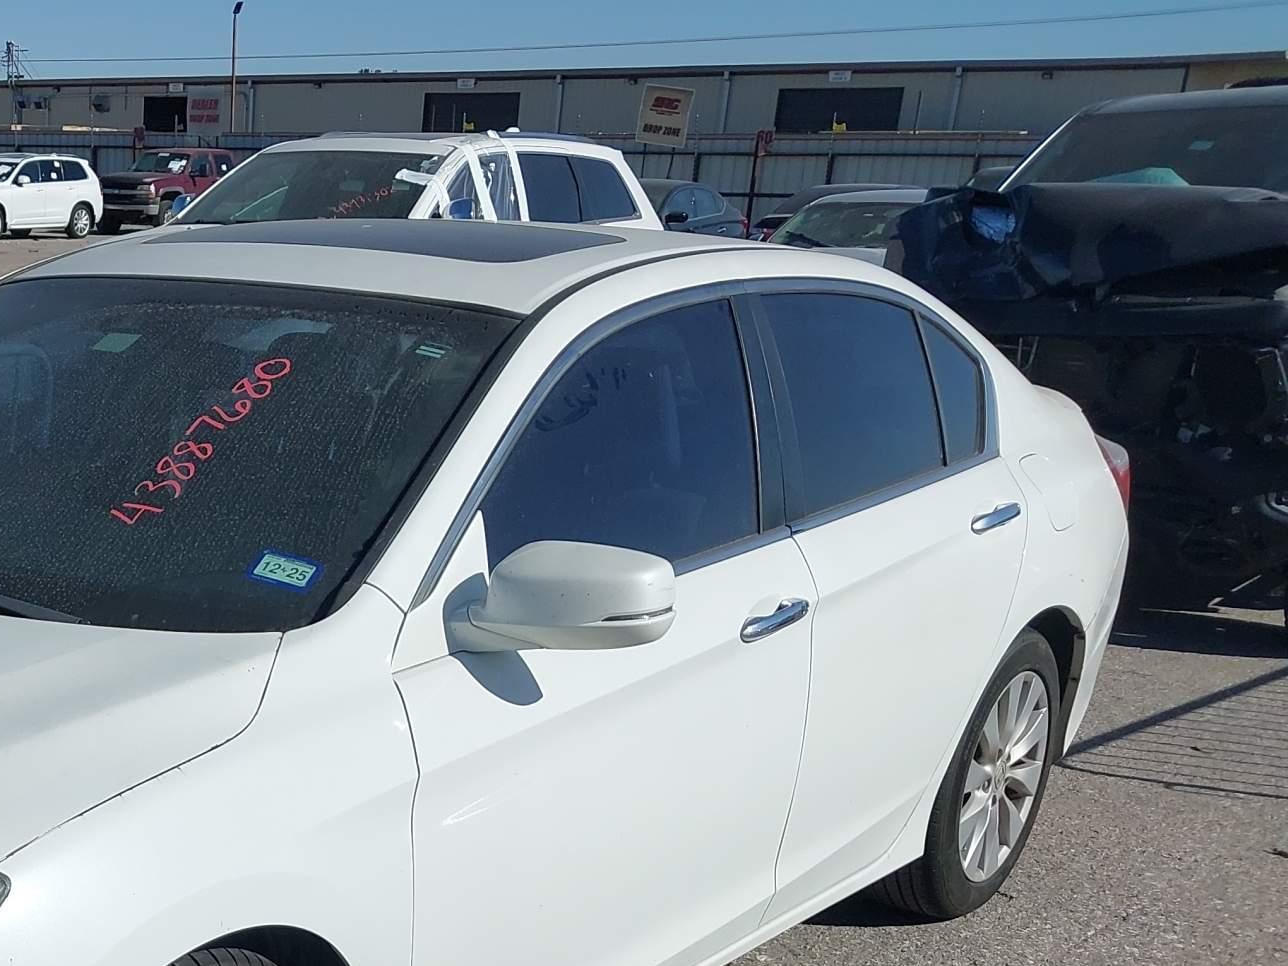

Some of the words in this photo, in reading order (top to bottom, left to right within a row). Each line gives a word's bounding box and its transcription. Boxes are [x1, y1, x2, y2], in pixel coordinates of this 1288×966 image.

[642, 123, 663, 135] DROP
[662, 126, 681, 137] ZONE
[110, 357, 292, 525] 43887680
